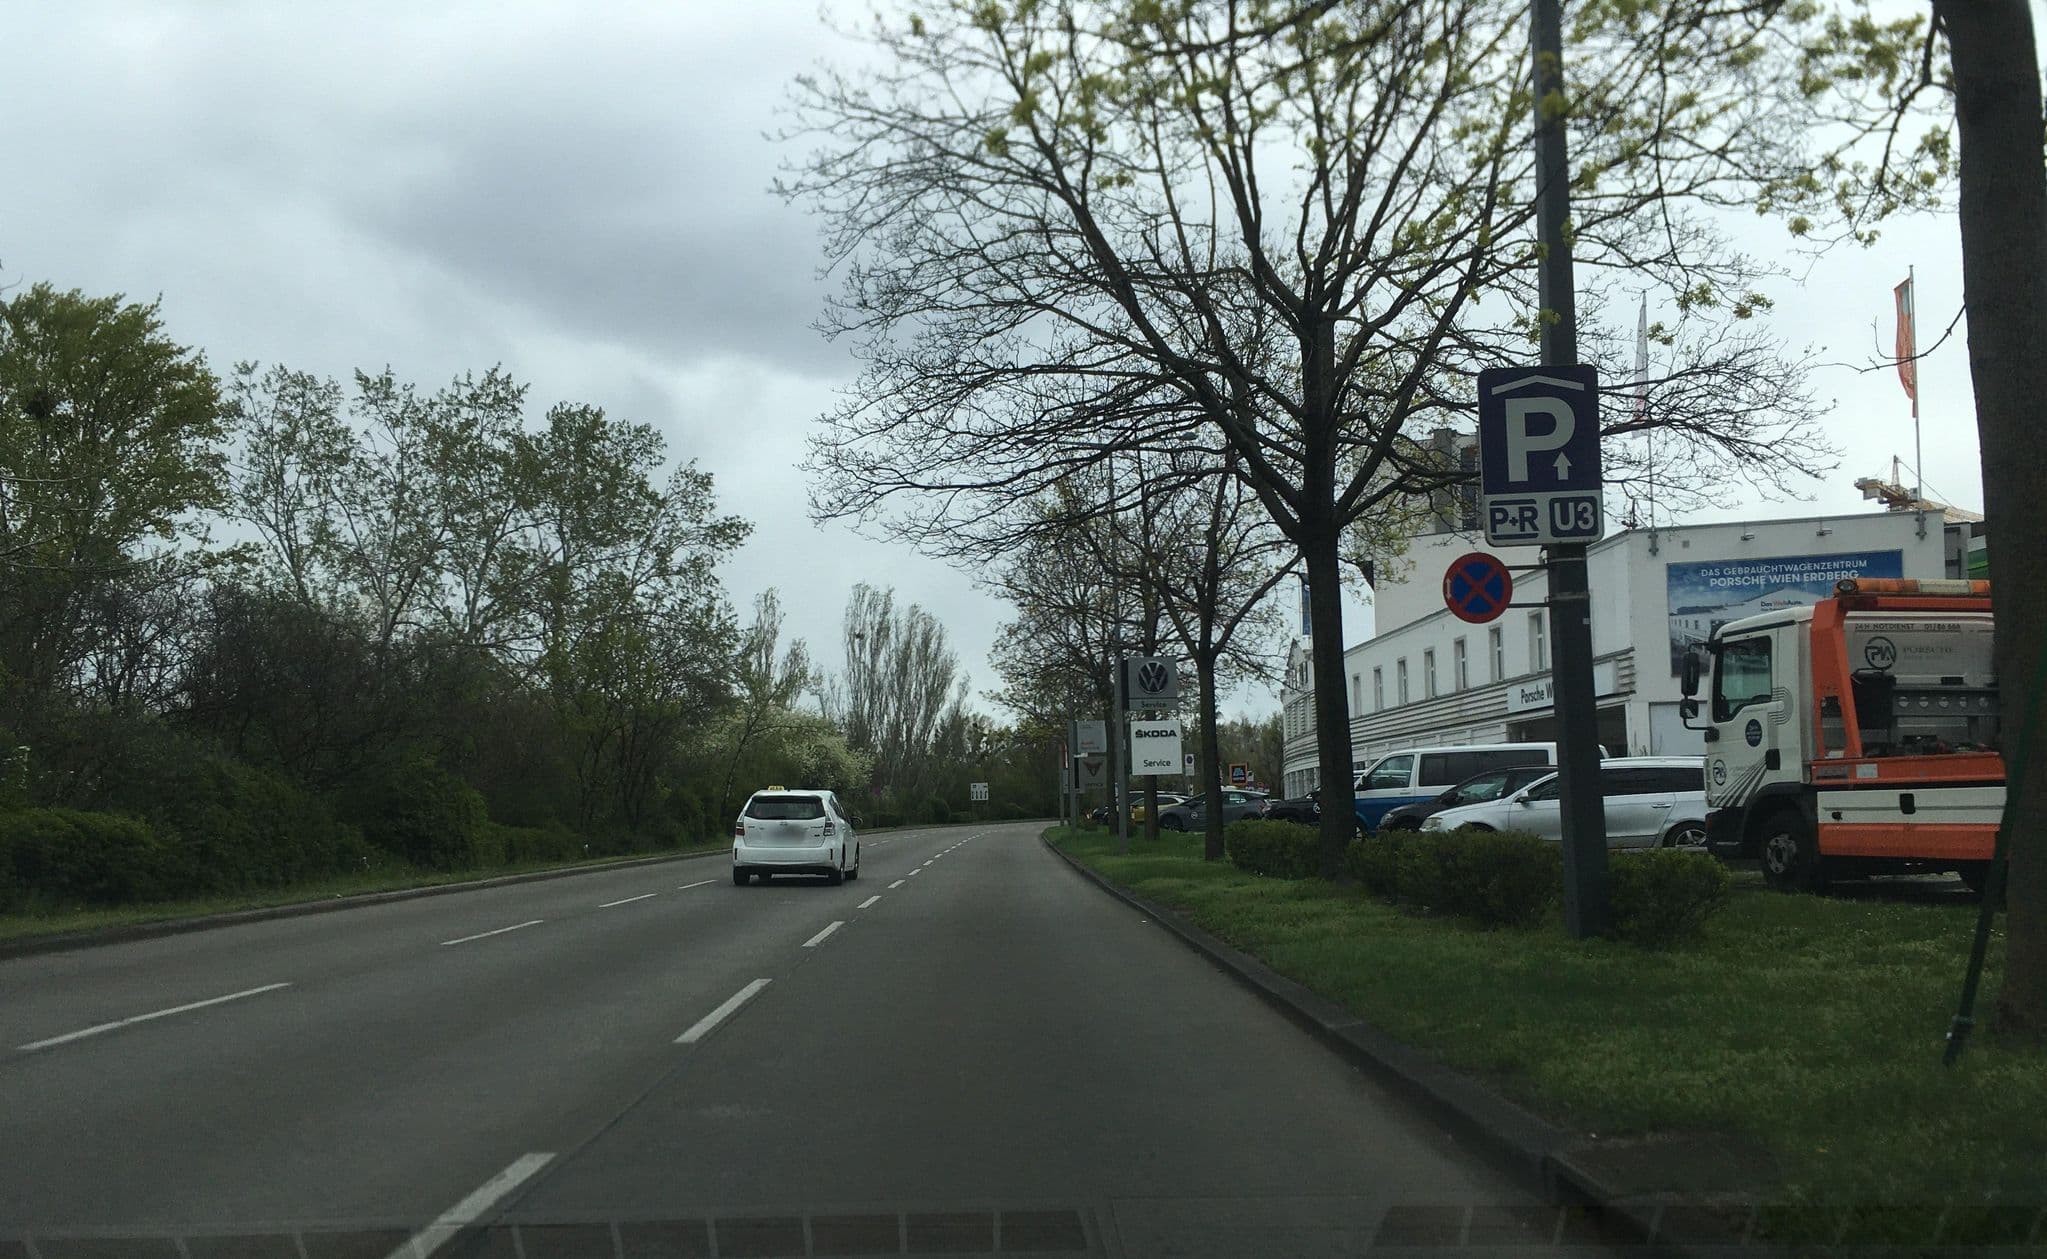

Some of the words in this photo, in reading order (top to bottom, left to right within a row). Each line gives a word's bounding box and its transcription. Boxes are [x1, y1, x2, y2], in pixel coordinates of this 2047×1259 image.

[1505, 396, 1576, 483] P
[1490, 506, 1540, 534] P+R
[1554, 501, 1595, 532] U3
[1701, 568, 1721, 577] DAS
[1724, 560, 1868, 576] GEBRAUCHTWAGENZENTRUM
[1709, 575, 1767, 588] PORSCHE
[1769, 573, 1801, 584] WIEN
[1803, 570, 1860, 582] ERDBERG
[1520, 683, 1545, 704] Porsche
[1135, 729, 1178, 738] ŠKODA
[1143, 759, 1172, 768] Service
